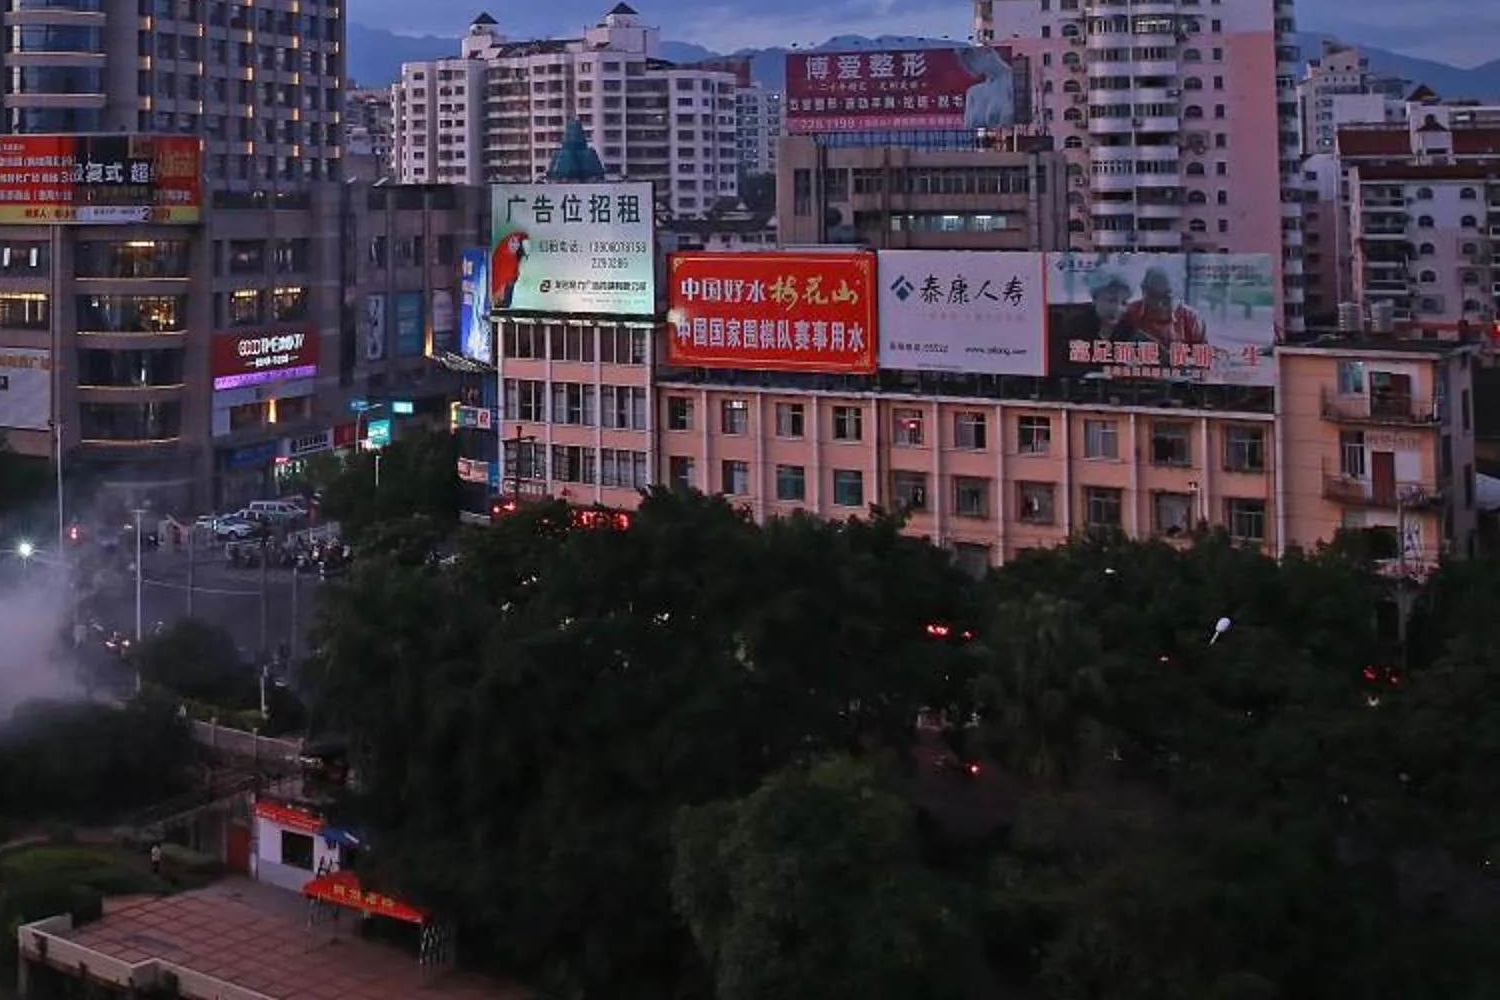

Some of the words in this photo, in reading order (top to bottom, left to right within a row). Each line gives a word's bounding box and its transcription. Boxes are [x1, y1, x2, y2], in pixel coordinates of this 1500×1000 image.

[805, 52, 928, 80] 博爱整形
[506, 193, 641, 224] 广告位招租
[920, 273, 1026, 306] 泰康人寿
[677, 317, 865, 352] 中国国家围棋队赛事用水
